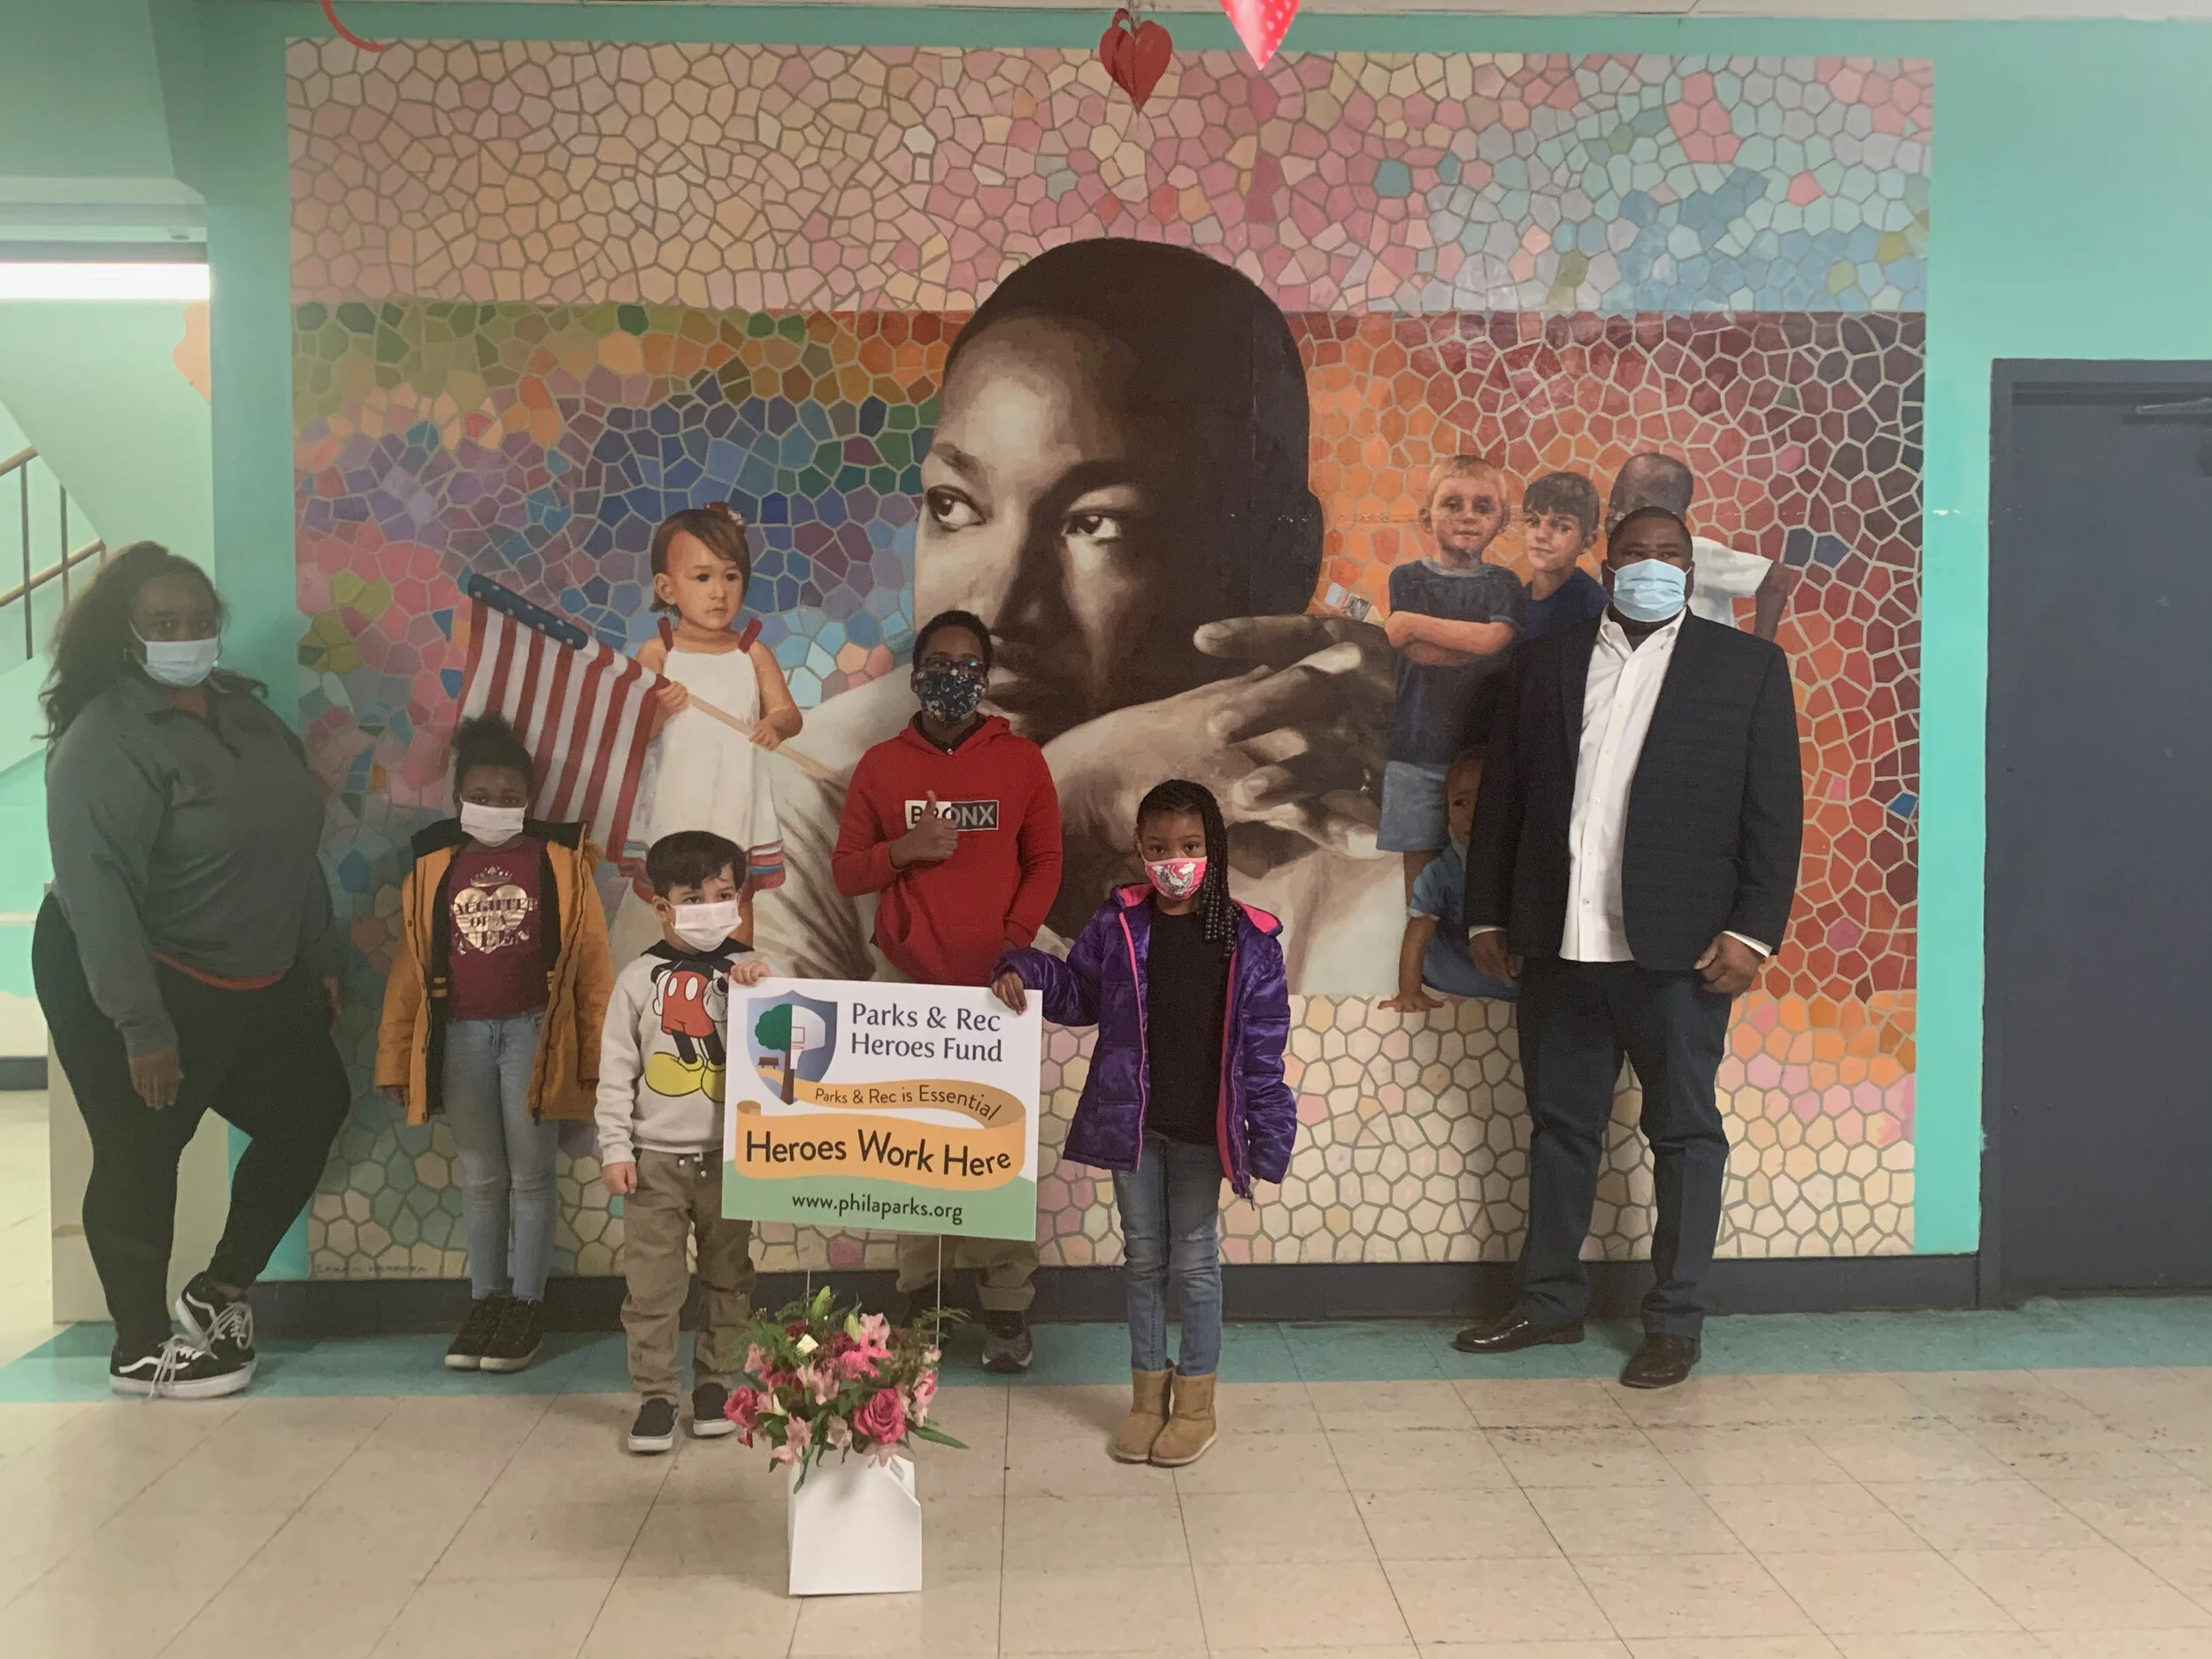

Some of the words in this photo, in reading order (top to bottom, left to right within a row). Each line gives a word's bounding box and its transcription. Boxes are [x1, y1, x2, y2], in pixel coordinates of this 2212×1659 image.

[910, 804, 995, 826] BONX
[852, 1002, 918, 1028] Parks
[926, 1006, 947, 1030] &
[956, 1008, 1001, 1033] Rec
[851, 1033, 935, 1058] Heroes
[943, 1037, 1002, 1063] Fund
[815, 1087, 848, 1104] Parks
[852, 1089, 864, 1104] &
[869, 1088, 897, 1104] Rec
[902, 1087, 913, 1103] is
[918, 1084, 1002, 1121] Essential
[746, 1130, 847, 1163] Heroes
[857, 1128, 934, 1173] Work
[943, 1144, 1011, 1177] Here
[792, 1193, 963, 1225] www.philaparks.org
